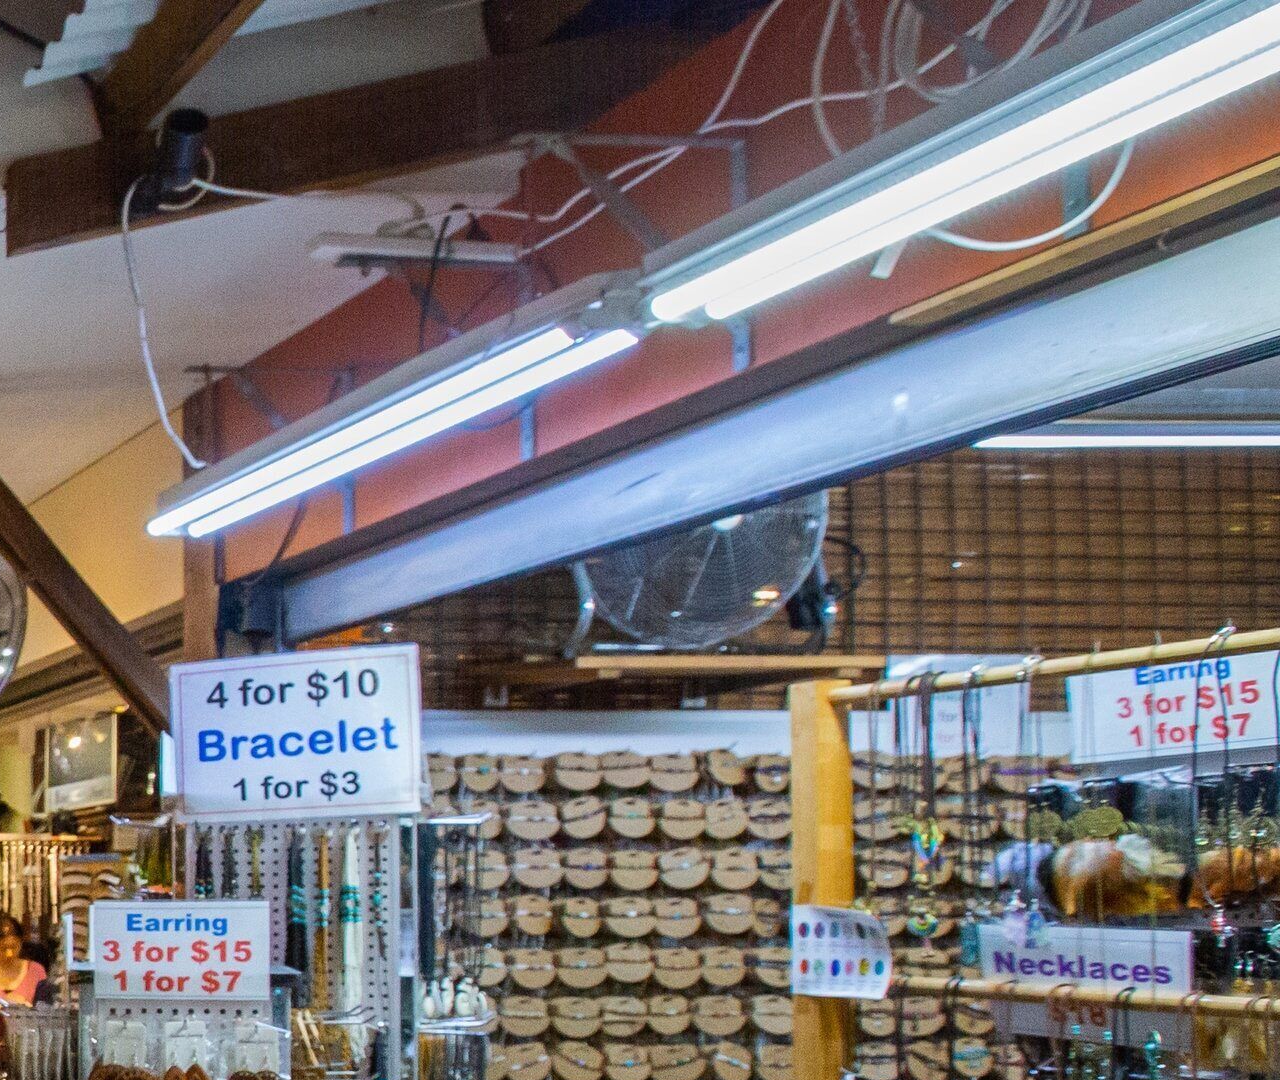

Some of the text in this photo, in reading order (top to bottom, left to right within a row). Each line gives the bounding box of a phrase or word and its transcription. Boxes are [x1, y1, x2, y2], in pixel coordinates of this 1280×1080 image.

[207, 668, 380, 708] 4 for $10
[1116, 679, 1260, 718] 3 for $15
[198, 717, 398, 762] Bracelet
[1130, 712, 1252, 746] 1 for $7
[233, 770, 361, 801] 1 for $3
[126, 913, 228, 935] Earring
[103, 939, 253, 965] 3 for $15
[993, 951, 1173, 985] Necklaces
[113, 969, 242, 994] 1 for $7
